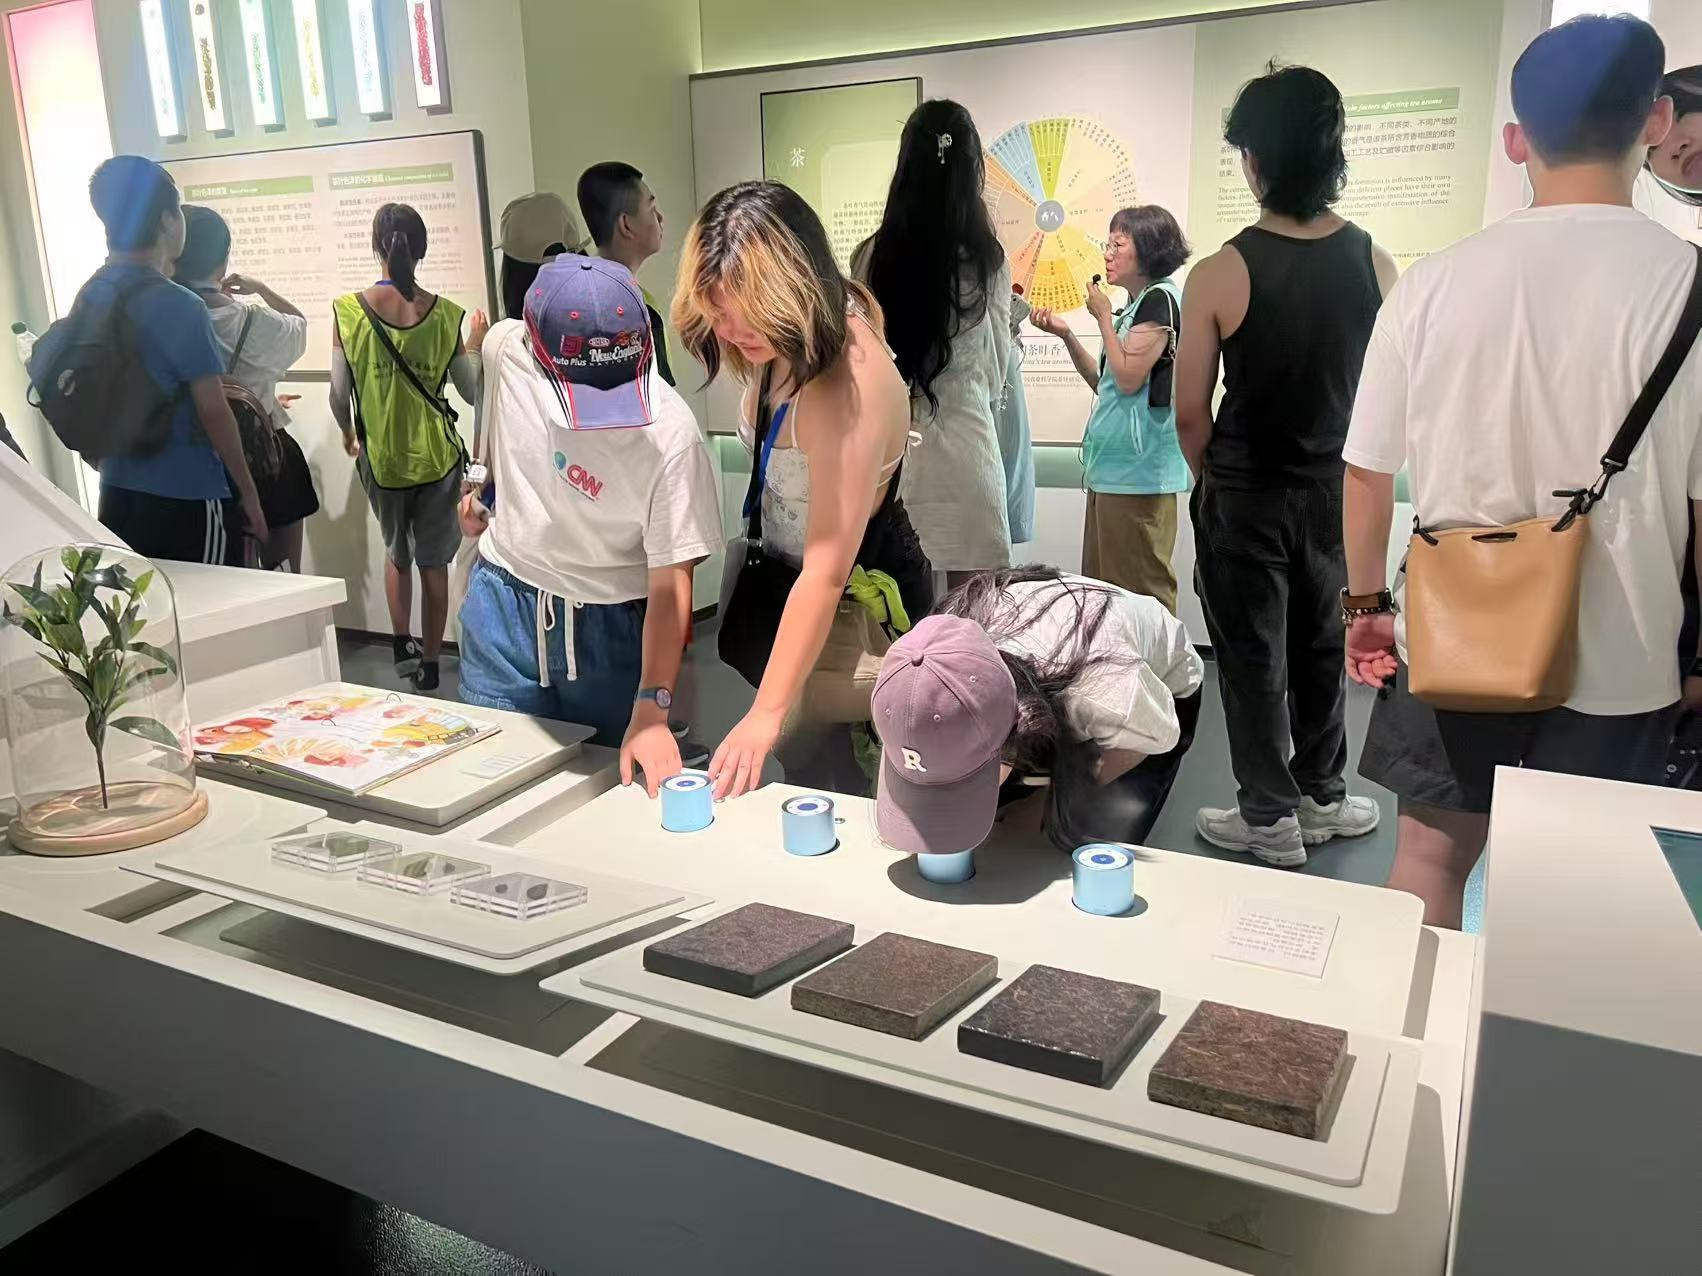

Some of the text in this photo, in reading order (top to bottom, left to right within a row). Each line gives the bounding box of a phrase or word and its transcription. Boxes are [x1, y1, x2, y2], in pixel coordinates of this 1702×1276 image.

[1358, 102, 1380, 112] factors
[1381, 100, 1409, 111] affecting
[1410, 99, 1420, 107] tea
[1421, 98, 1443, 106] aroma
[790, 147, 806, 168] 茶
[552, 356, 569, 365] Auto
[570, 358, 587, 366] Plus
[589, 349, 613, 362] New
[612, 338, 643, 360] England
[567, 464, 603, 498] CNN
[901, 747, 928, 773] R
